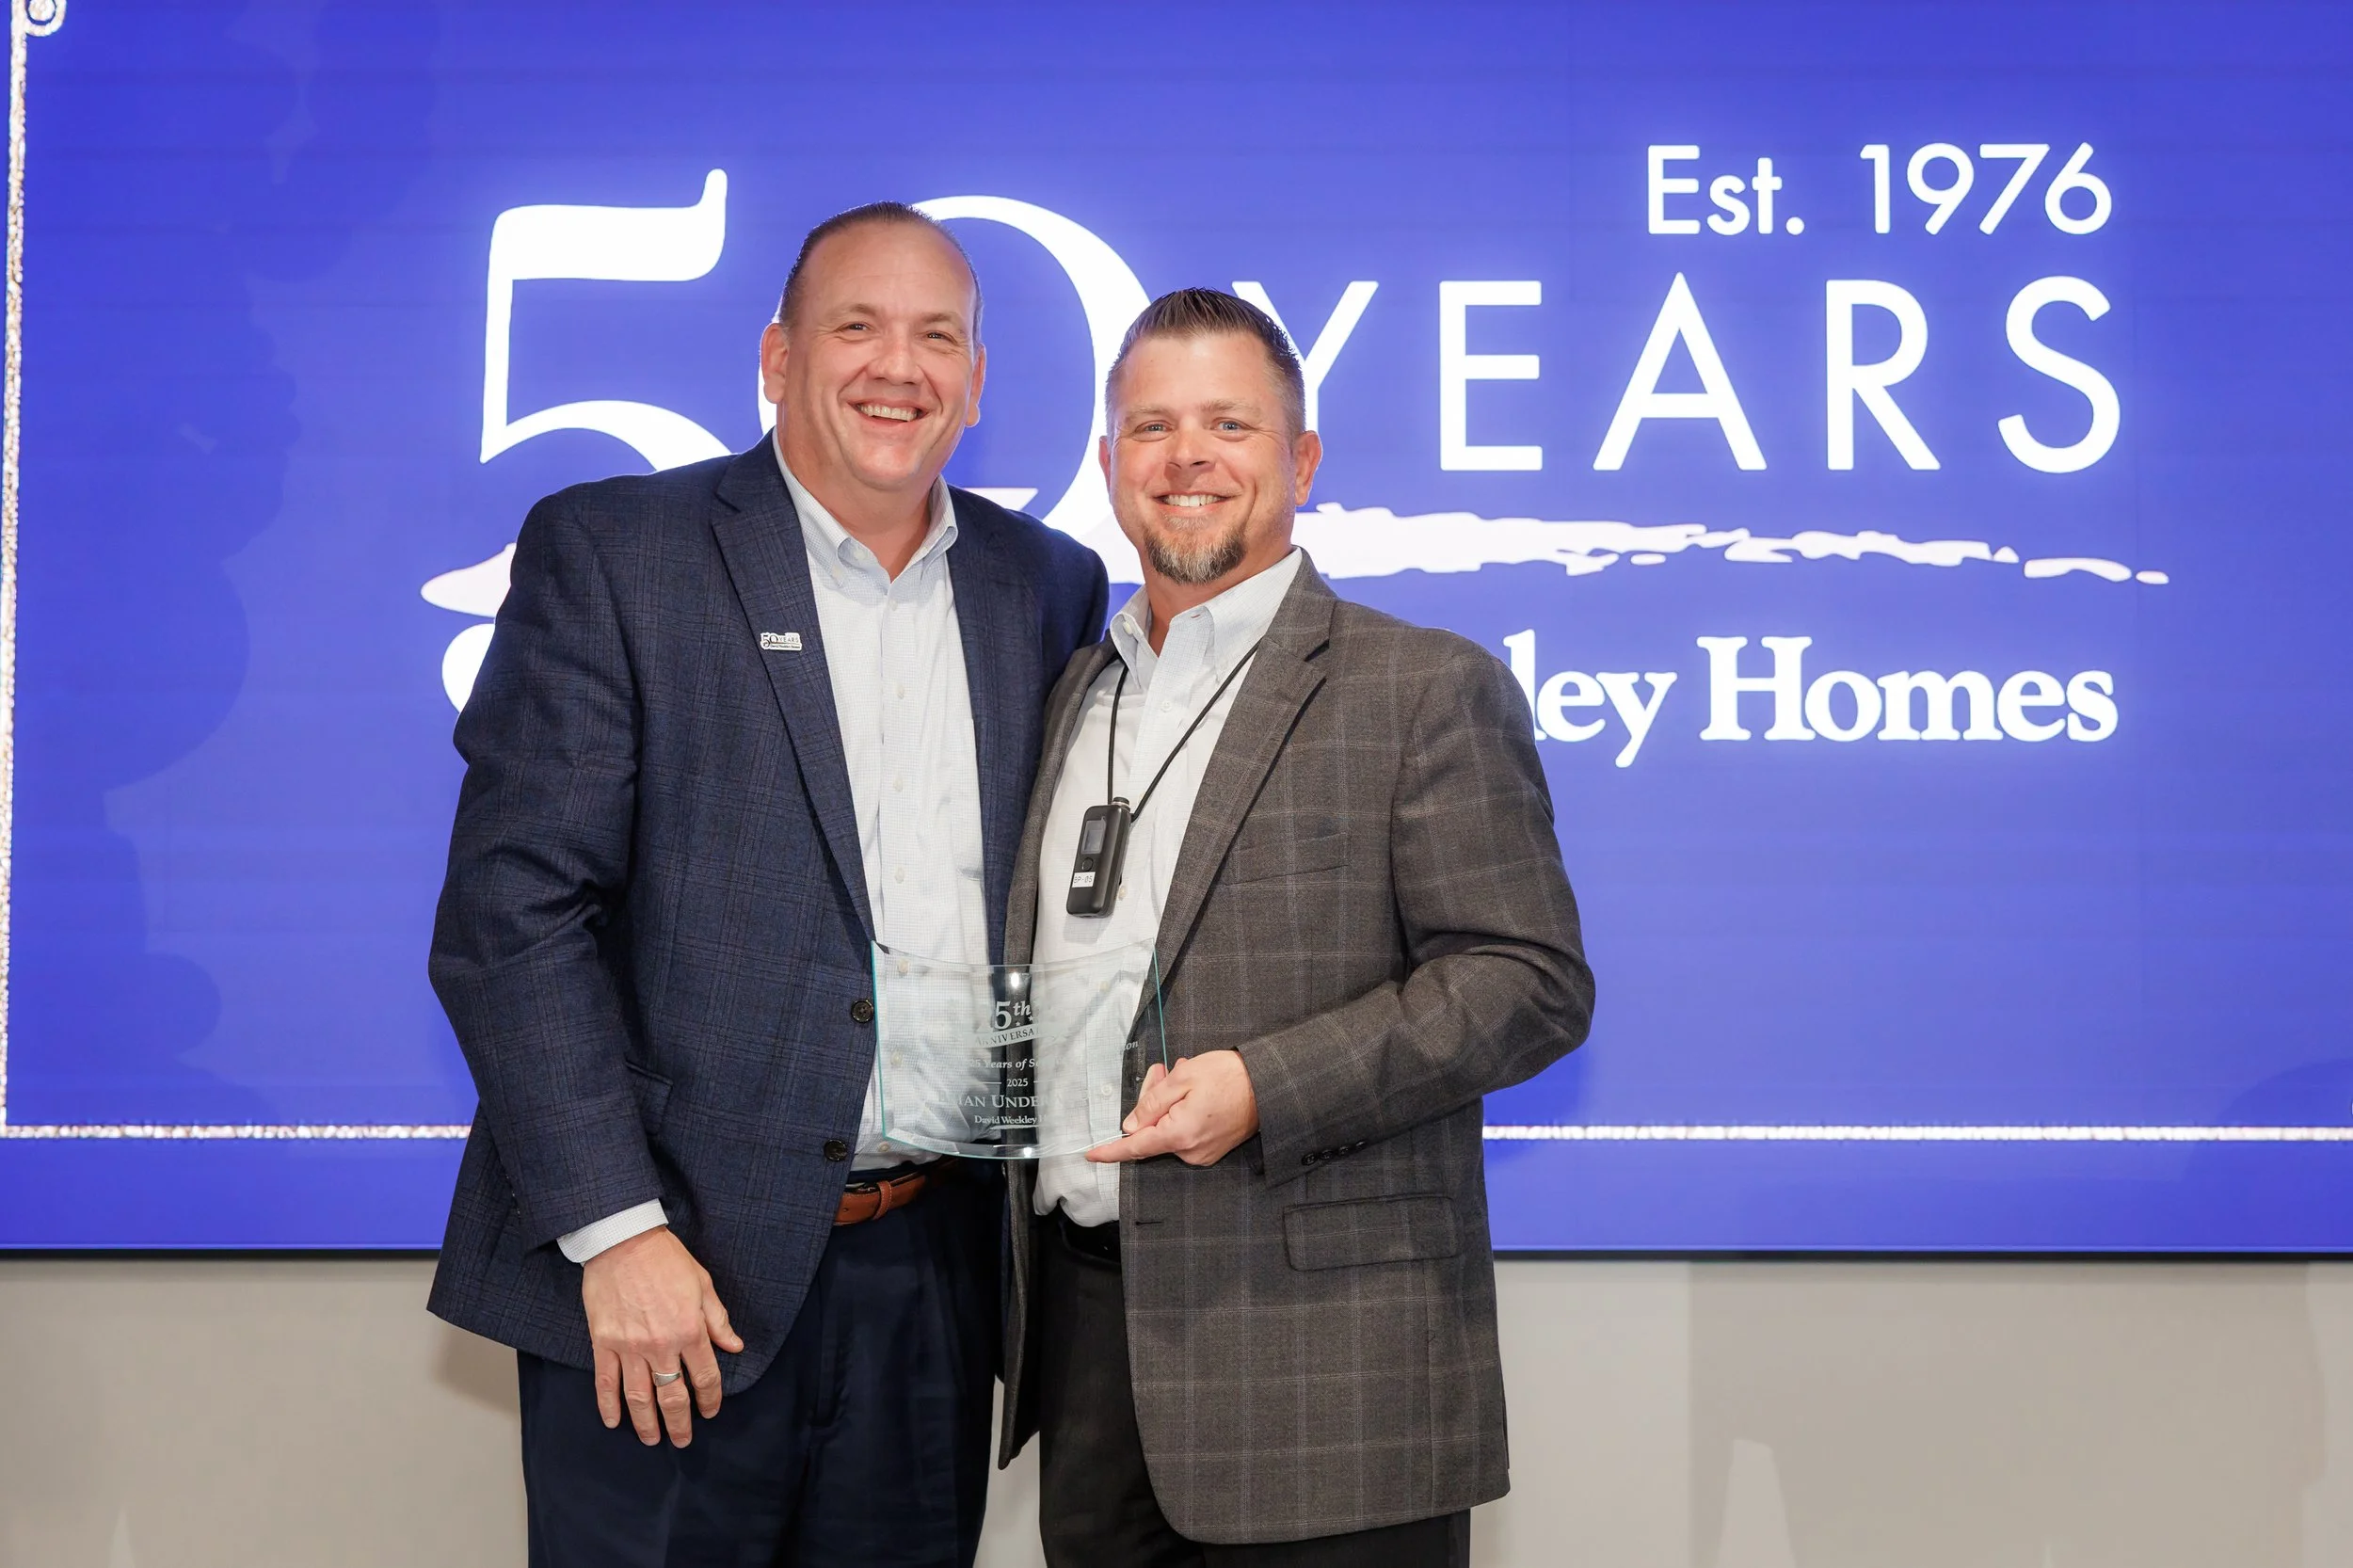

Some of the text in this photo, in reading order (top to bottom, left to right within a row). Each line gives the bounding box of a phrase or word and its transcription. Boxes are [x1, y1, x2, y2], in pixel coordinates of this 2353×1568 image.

[1648, 142, 2112, 236] Est. 1976
[1232, 274, 2121, 473] YEARS
[1697, 635, 2118, 742] Homes
[1006, 1078, 1029, 1088] 2025
[1016, 1058, 1028, 1071] of
[974, 1114, 1000, 1126] David
[1001, 1114, 1037, 1126] Weekley
